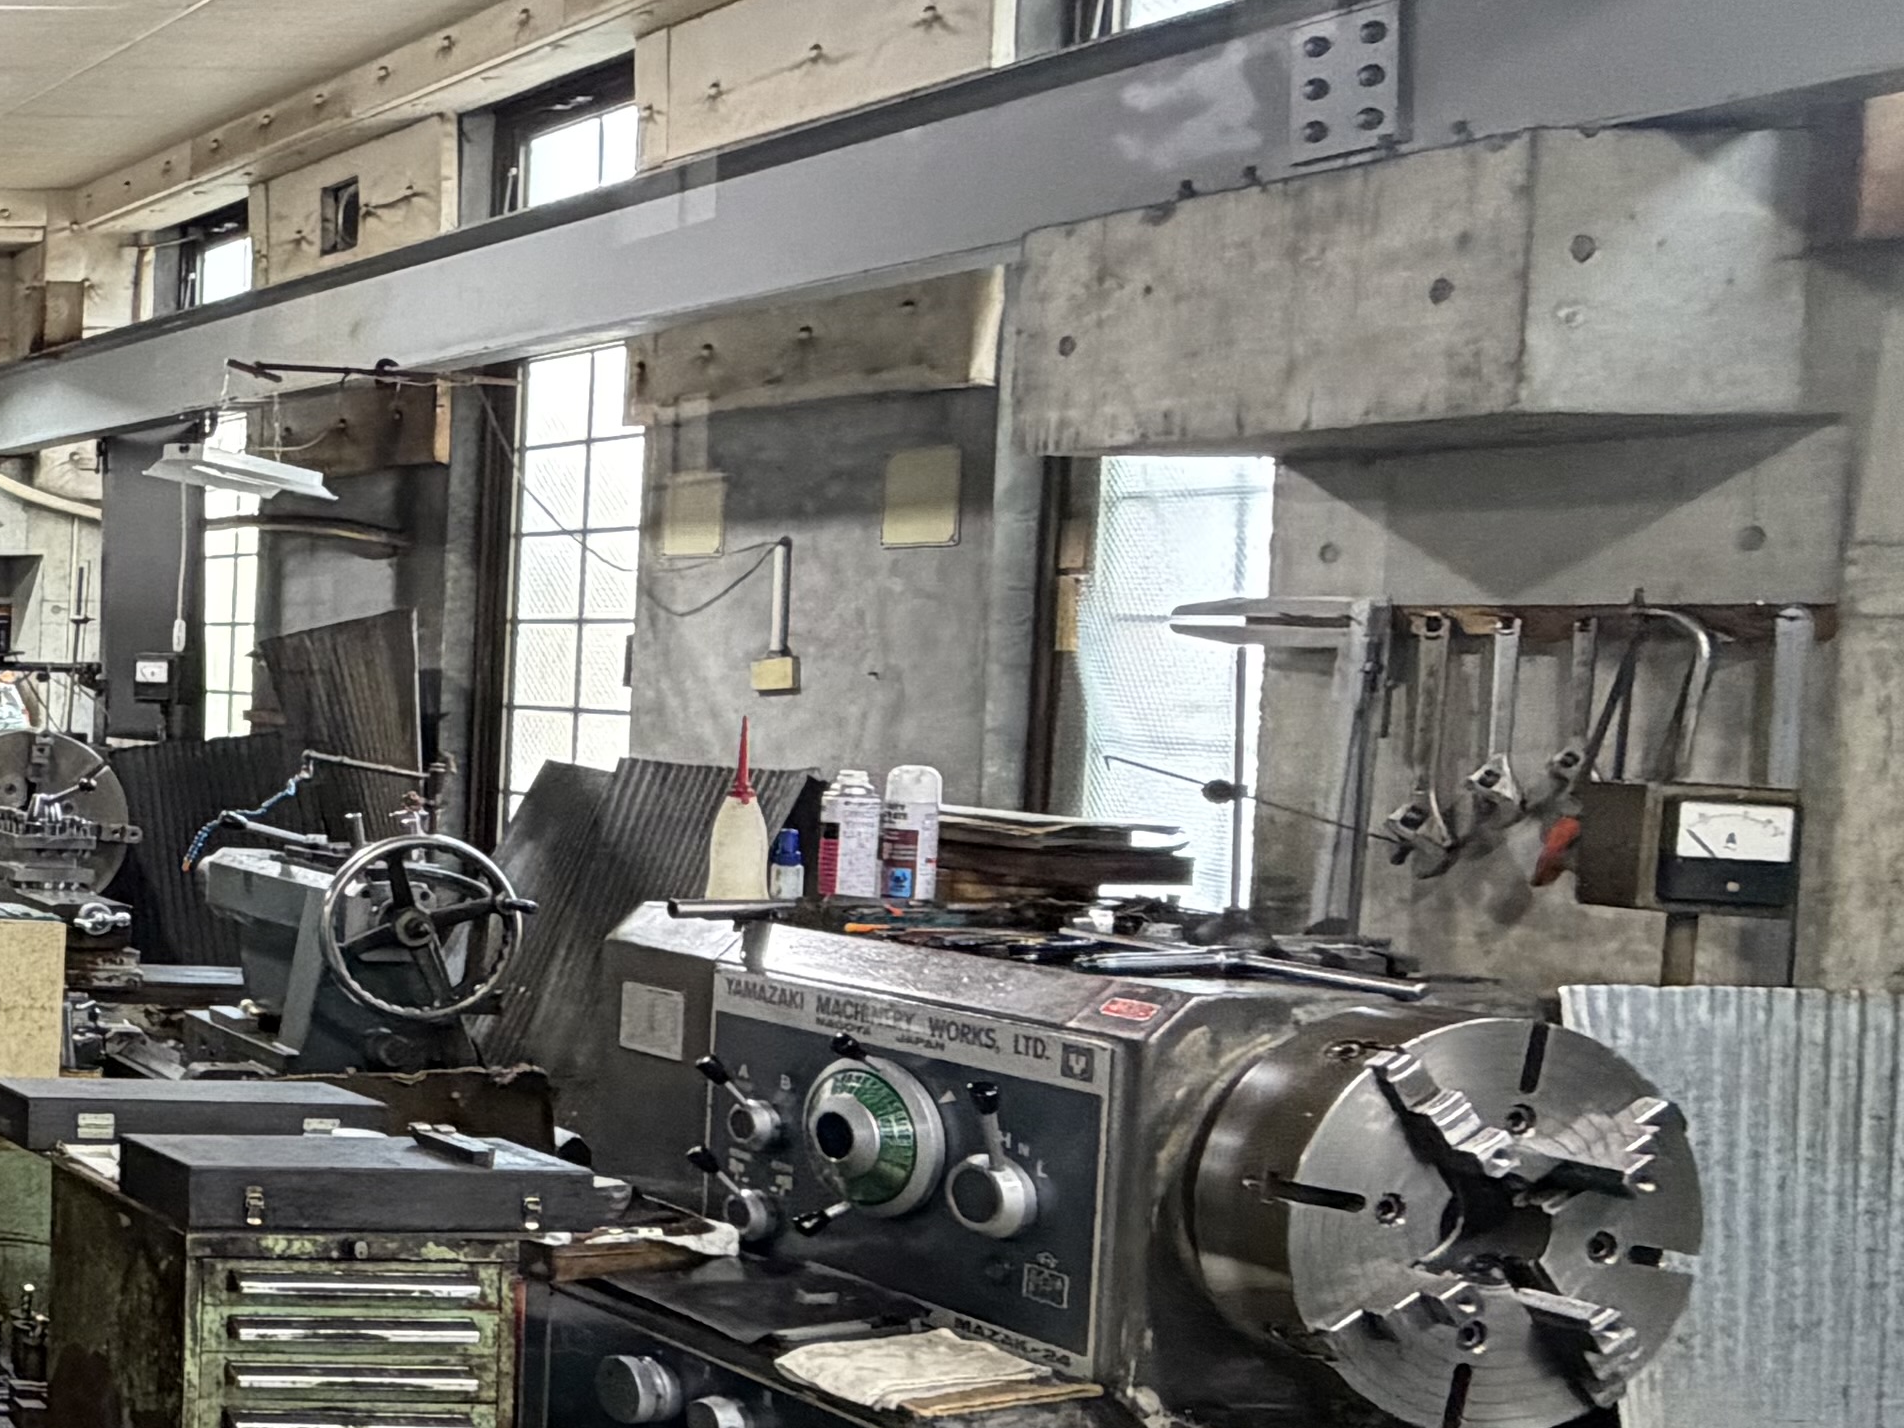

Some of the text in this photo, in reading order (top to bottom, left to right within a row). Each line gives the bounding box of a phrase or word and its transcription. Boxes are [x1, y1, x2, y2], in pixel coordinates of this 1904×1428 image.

[727, 978, 805, 1010] YAMAZAKI
[928, 1017, 1000, 1054] WORKS,
[1013, 1034, 1051, 1060] LTD.
[896, 1034, 945, 1051] JAPAN
